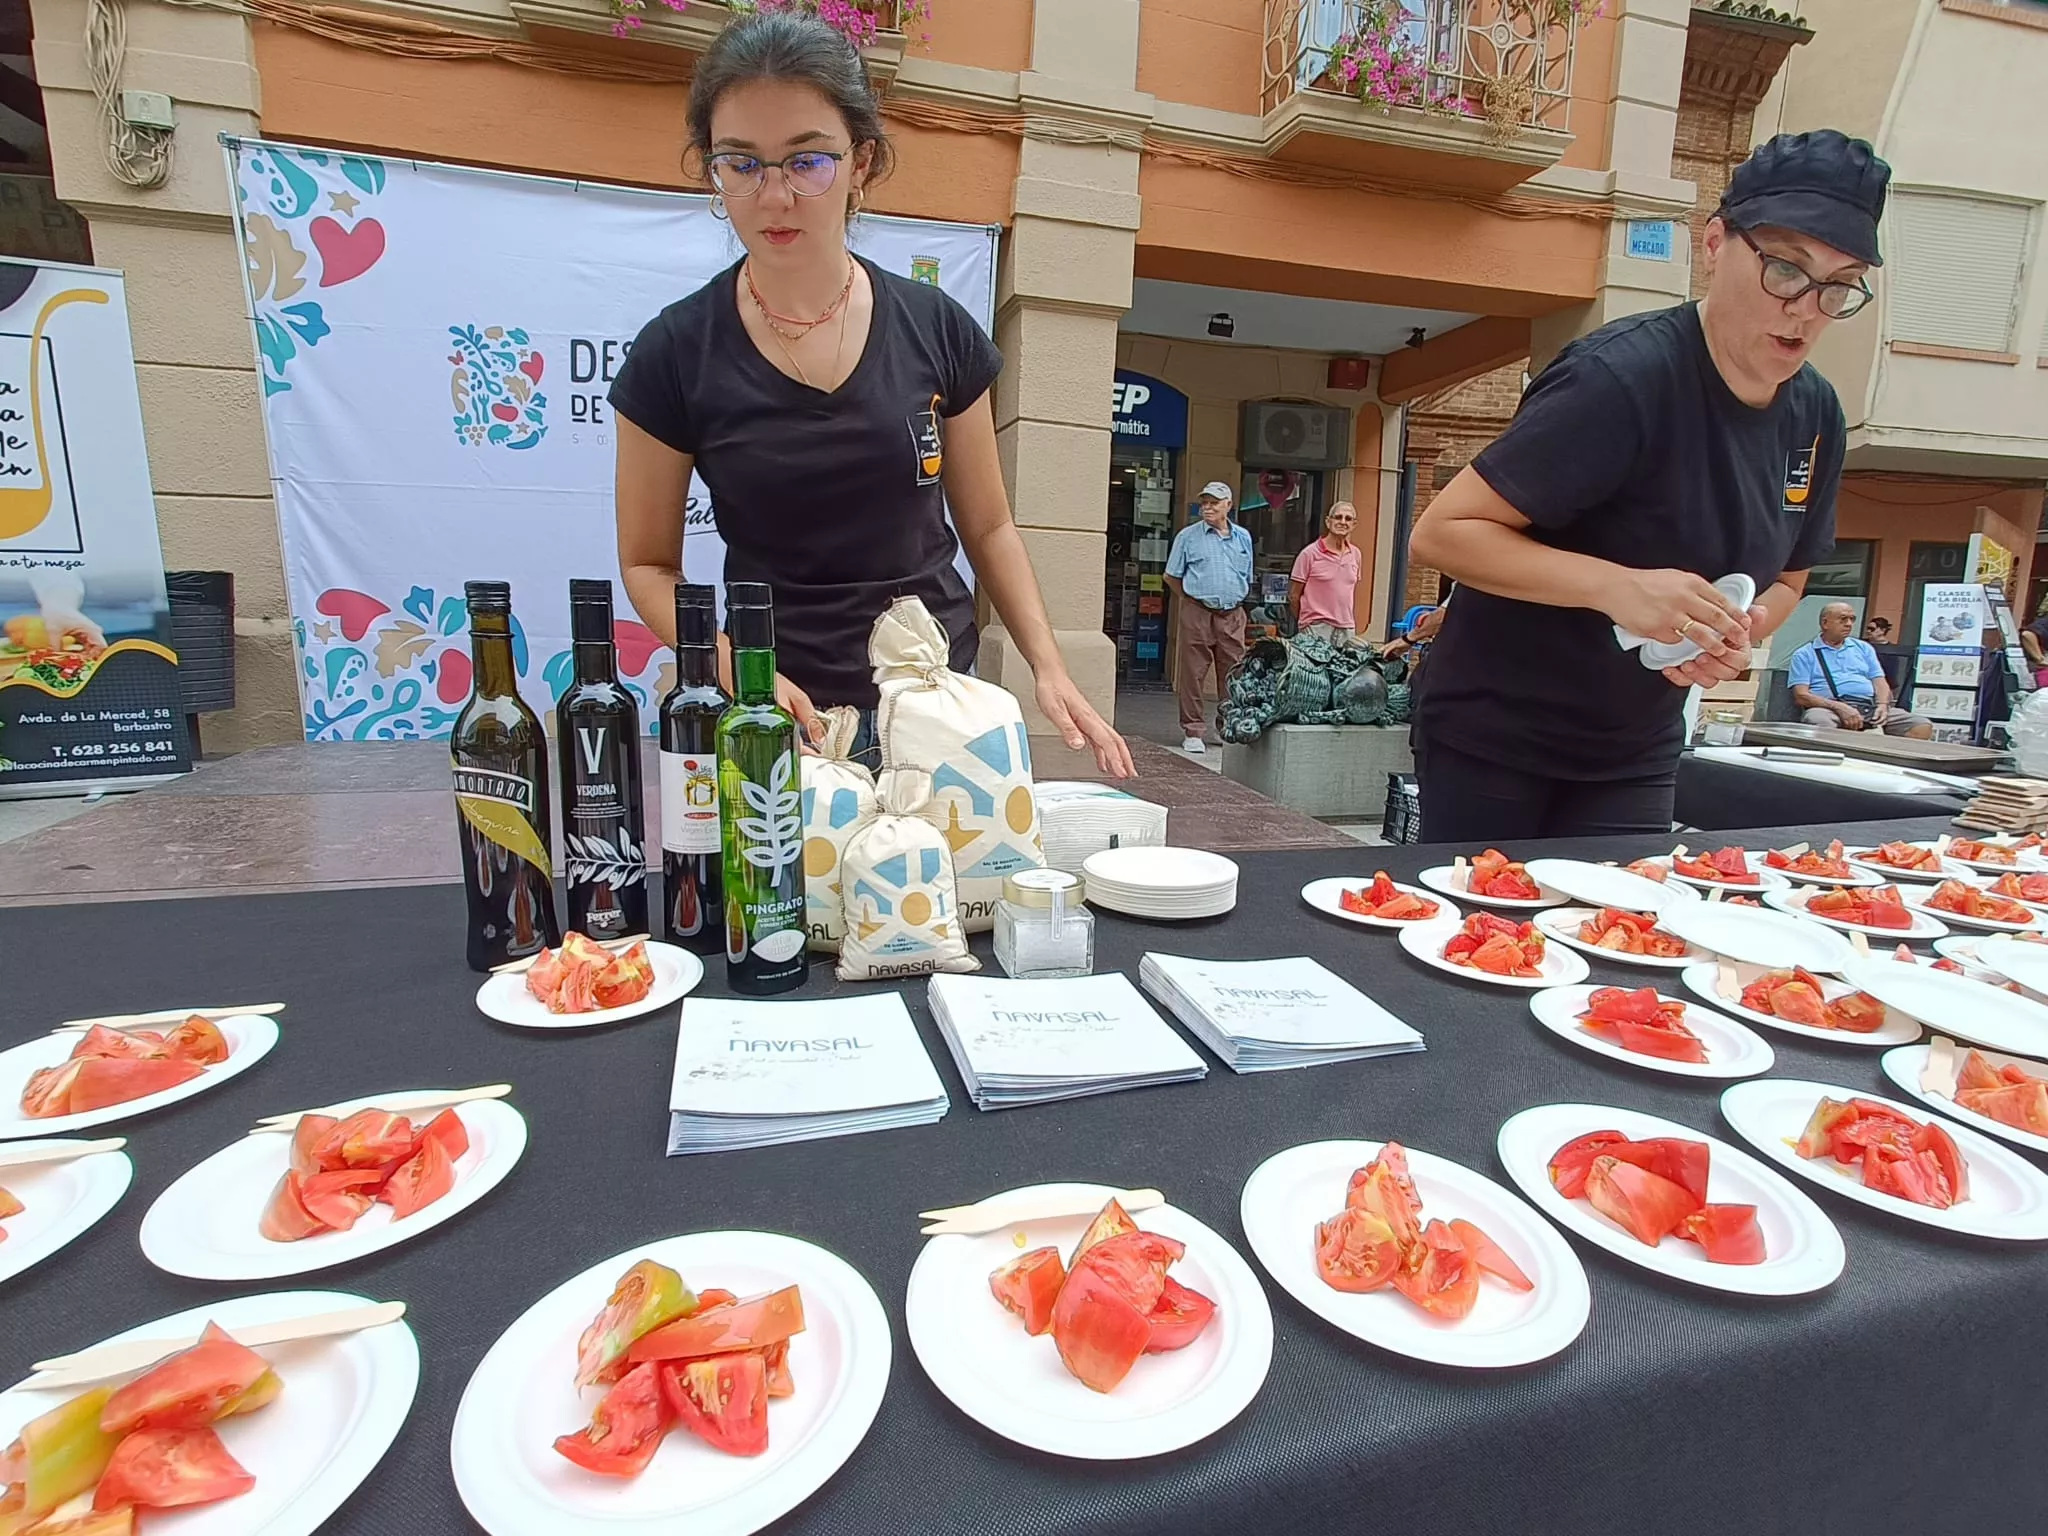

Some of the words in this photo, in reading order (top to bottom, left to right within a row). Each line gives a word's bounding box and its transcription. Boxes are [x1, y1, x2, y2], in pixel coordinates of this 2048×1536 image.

[1632, 240, 1664, 255] MERCADO
[571, 394, 604, 424] DE
[44, 559, 85, 571] mesa
[19, 713, 57, 724] Avda.
[61, 711, 77, 722] de
[81, 712, 96, 721] La
[154, 708, 170, 719] 58
[114, 722, 172, 733] Barbastro
[52, 746, 67, 757] T.
[72, 745, 105, 756] 628
[109, 743, 140, 754] 256
[145, 741, 173, 752] 841
[577, 727, 607, 775] V
[745, 896, 804, 915] PINGRATO
[868, 958, 944, 977] NAVASAL
[1212, 986, 1329, 1000] NAVASAL
[992, 1010, 1121, 1023] NAVASAL
[729, 1036, 874, 1053] NAVASAL
